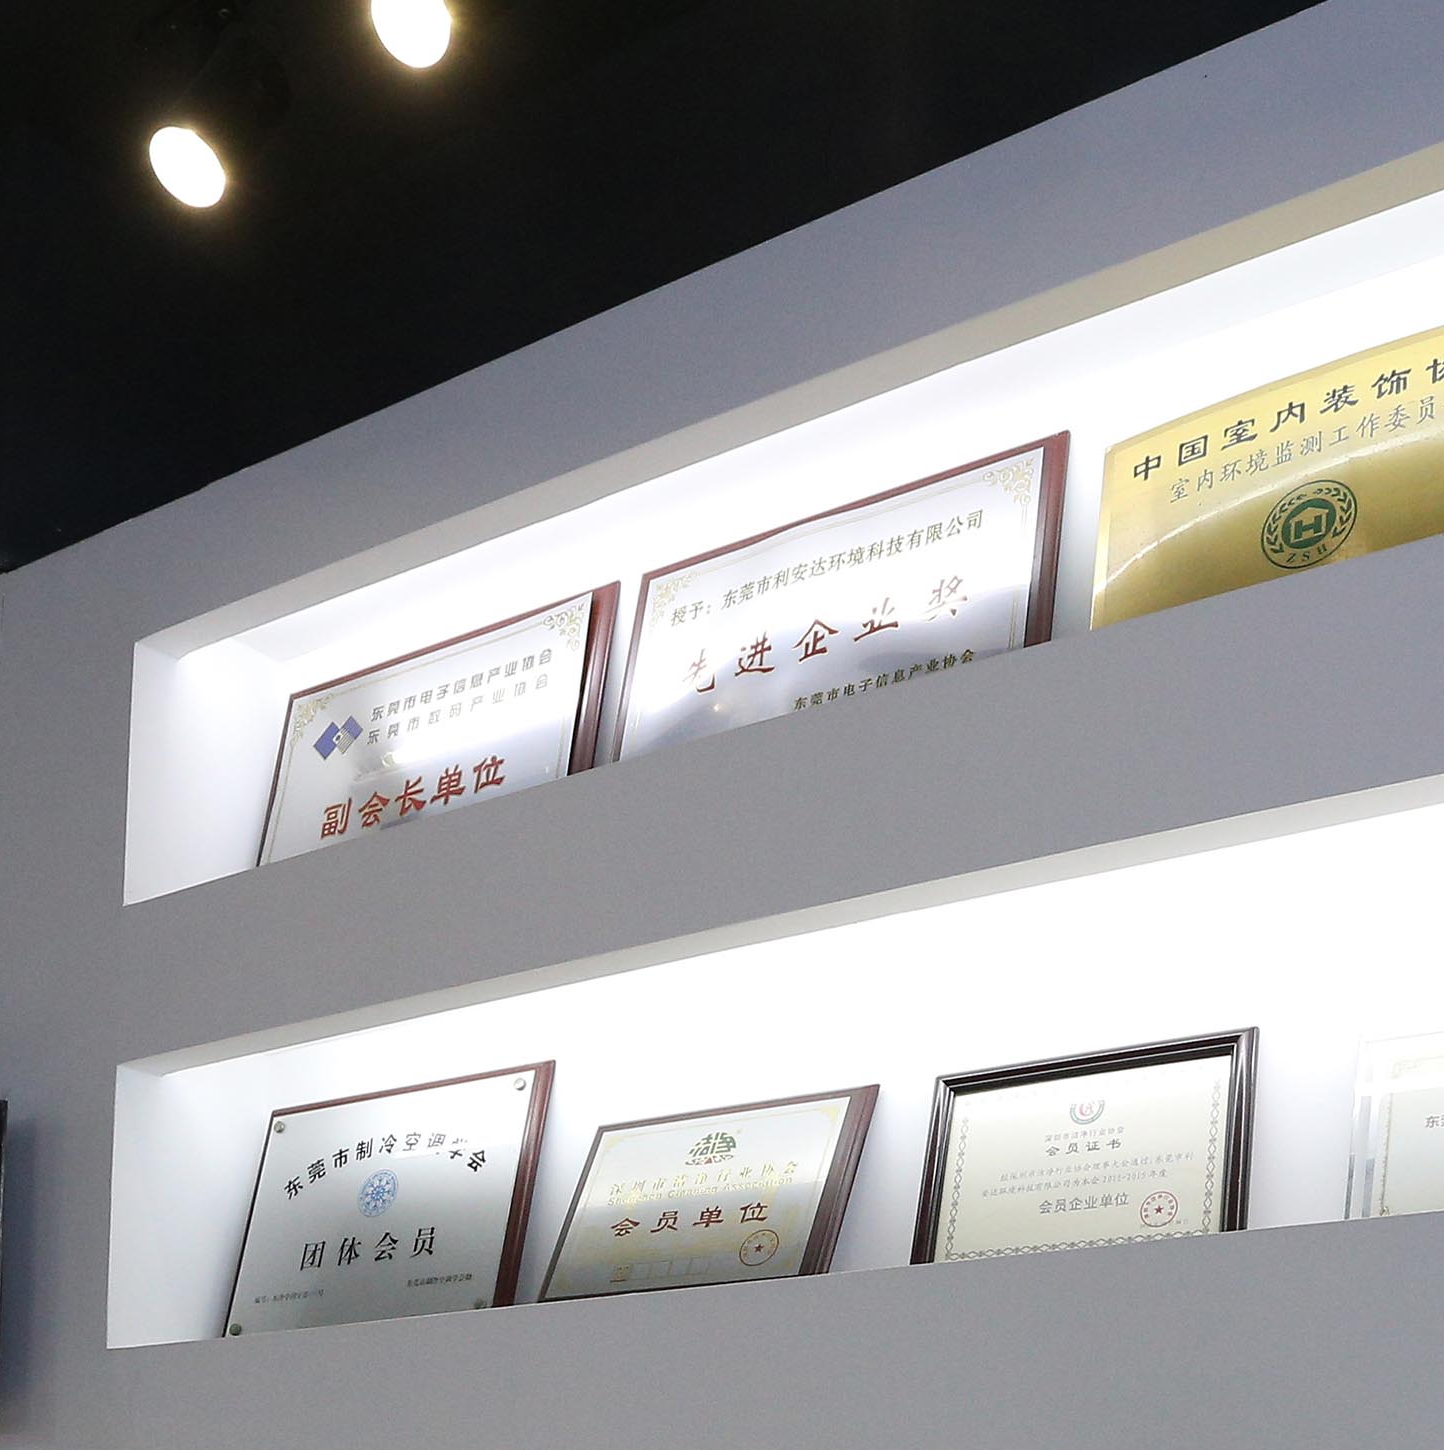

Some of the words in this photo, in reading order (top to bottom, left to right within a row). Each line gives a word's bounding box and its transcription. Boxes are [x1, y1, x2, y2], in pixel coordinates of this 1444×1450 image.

[682, 574, 968, 693] 先进企业奖
[370, 647, 553, 722] 东莞市电子信息产业协会
[792, 648, 976, 711] 东莞市电子信息产业协会
[319, 755, 507, 840] 副会长单位
[283, 1130, 488, 1201] 东莞市制冷空调学会
[1045, 1138, 1123, 1158] 会员证书
[610, 1201, 770, 1238] 会员单位
[1038, 1191, 1130, 1215] 会员企业单位
[299, 1225, 438, 1272] 团体会员
